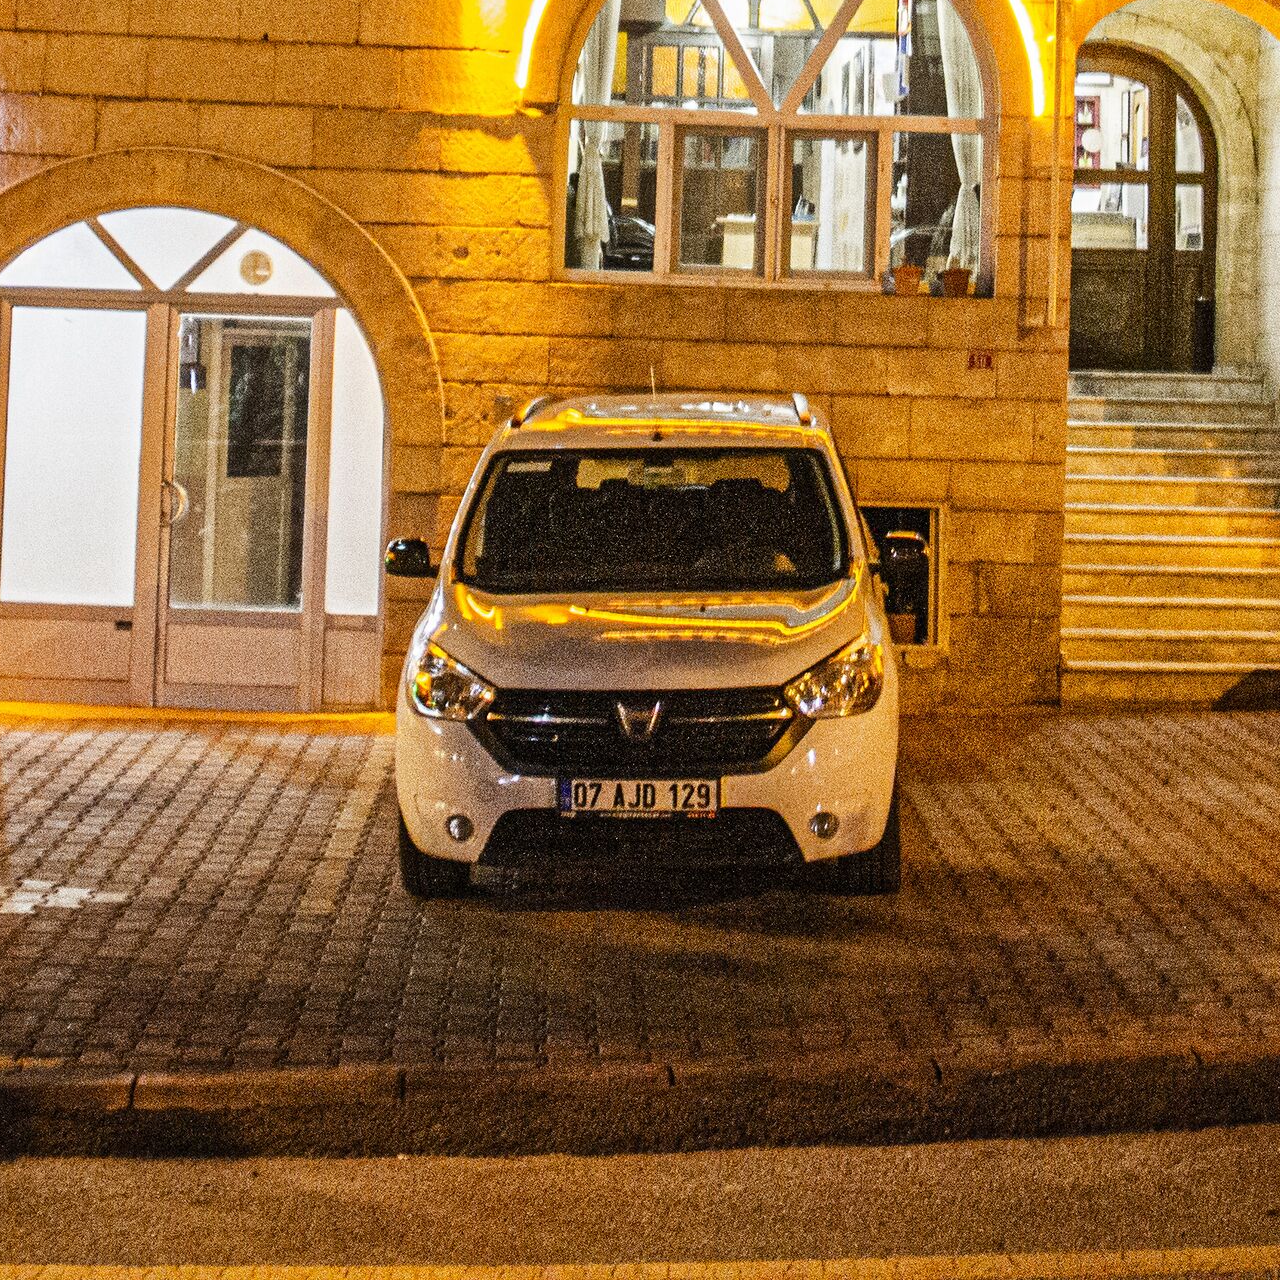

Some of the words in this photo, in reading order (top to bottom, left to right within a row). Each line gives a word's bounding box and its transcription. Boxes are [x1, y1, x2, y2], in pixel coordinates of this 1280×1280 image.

[573, 782, 602, 809] 07
[613, 782, 656, 809] AJD
[668, 782, 711, 810] 129
